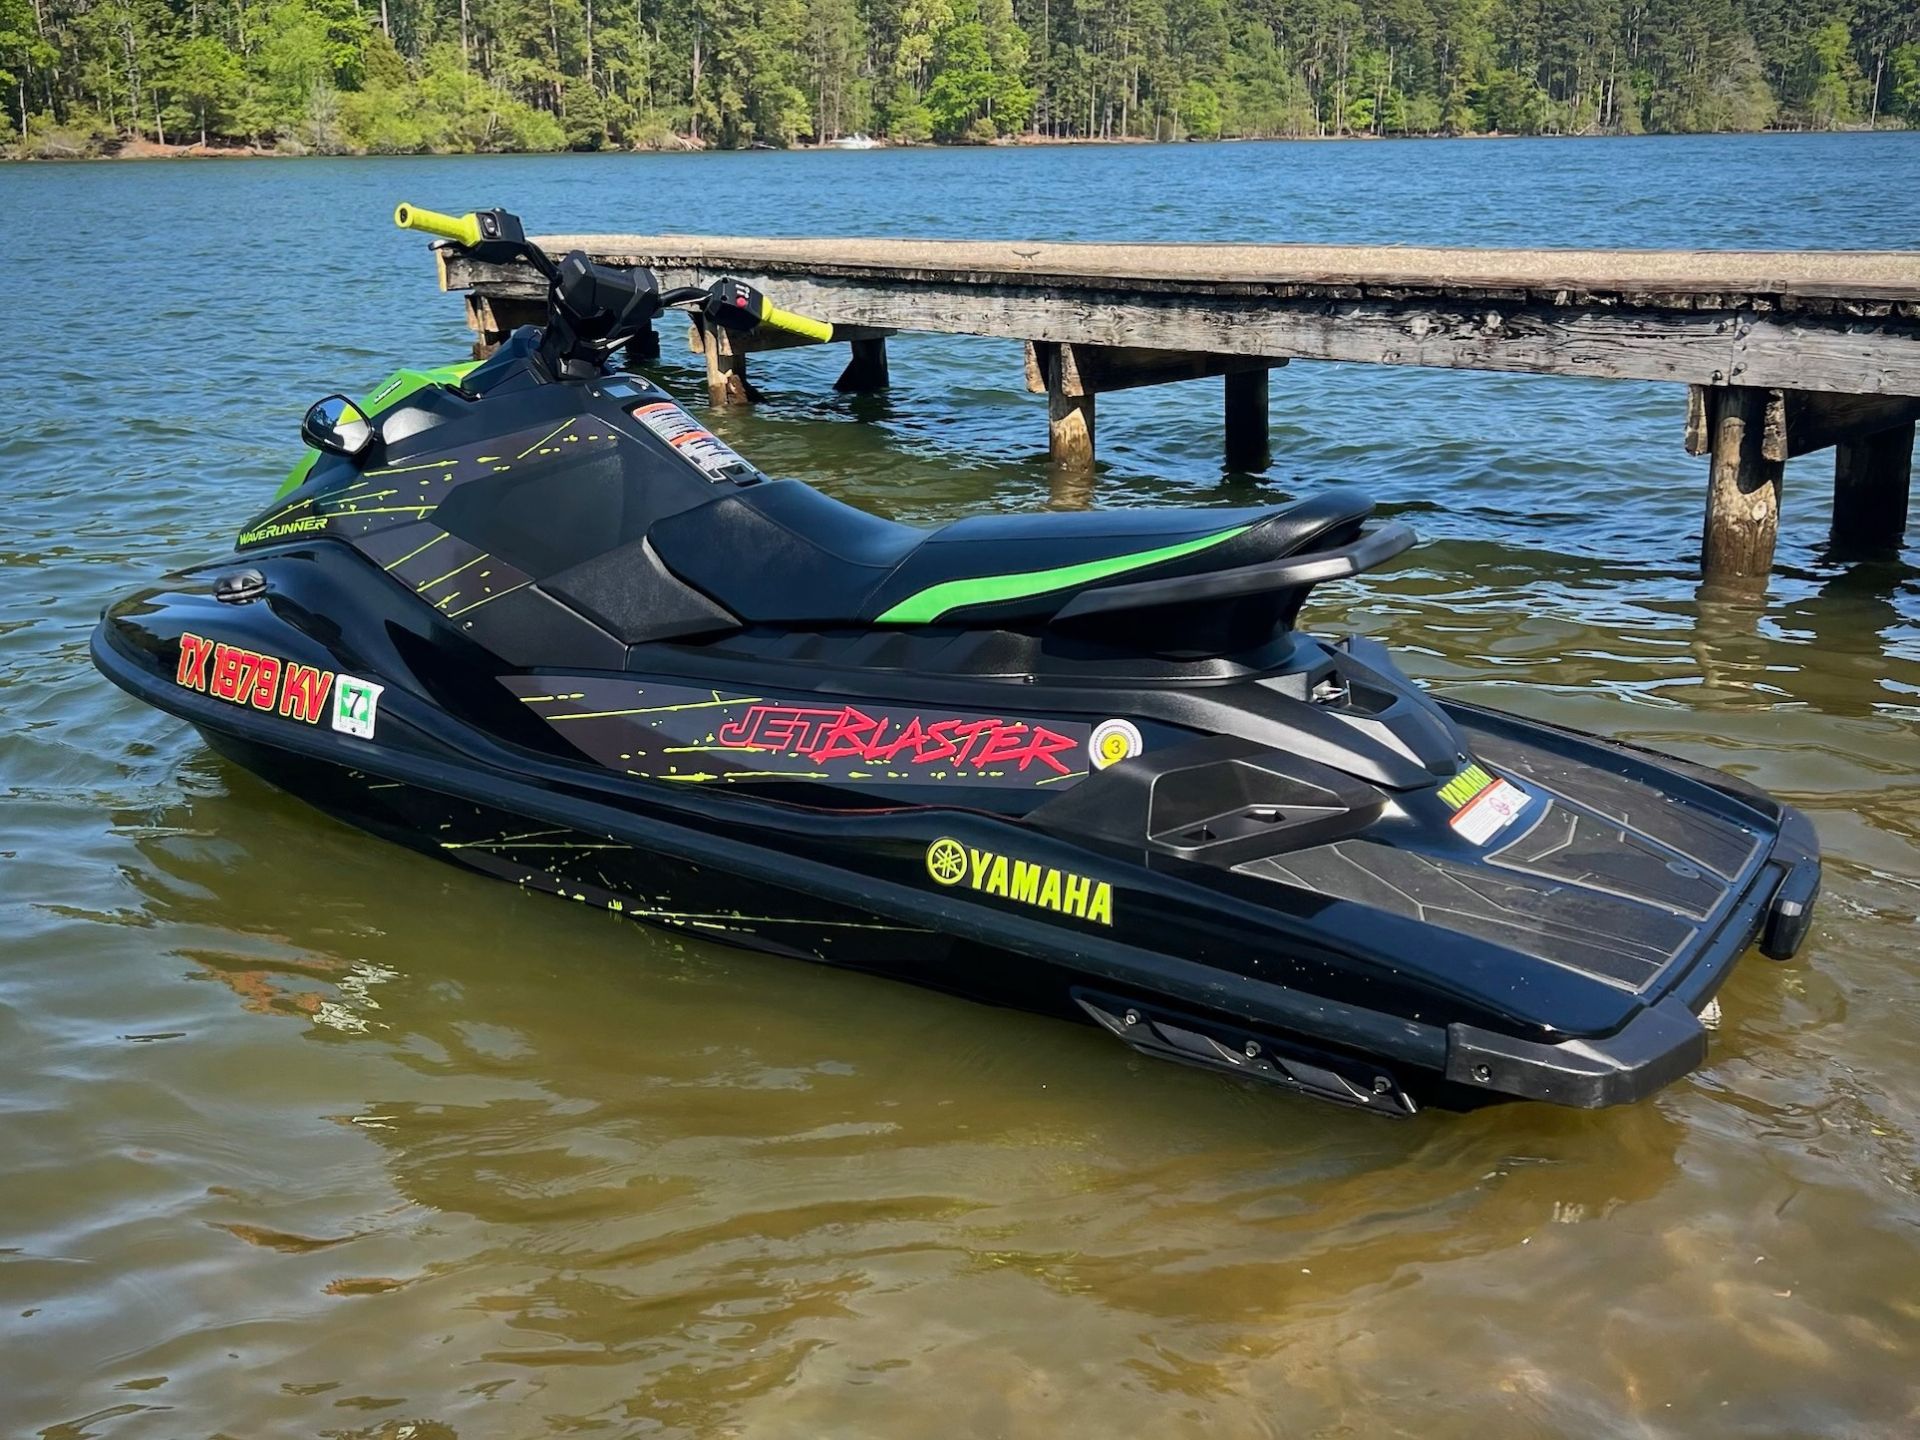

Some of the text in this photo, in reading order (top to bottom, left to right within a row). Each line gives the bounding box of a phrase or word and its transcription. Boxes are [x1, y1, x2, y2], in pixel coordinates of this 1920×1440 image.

[239, 518, 328, 545] WAVERUNNER
[177, 632, 334, 724] TX 1979 KV
[349, 688, 363, 718] 7
[1111, 739, 1121, 755] 3
[1436, 764, 1494, 810] YAMAHA
[969, 848, 1114, 926] YAMAHA
